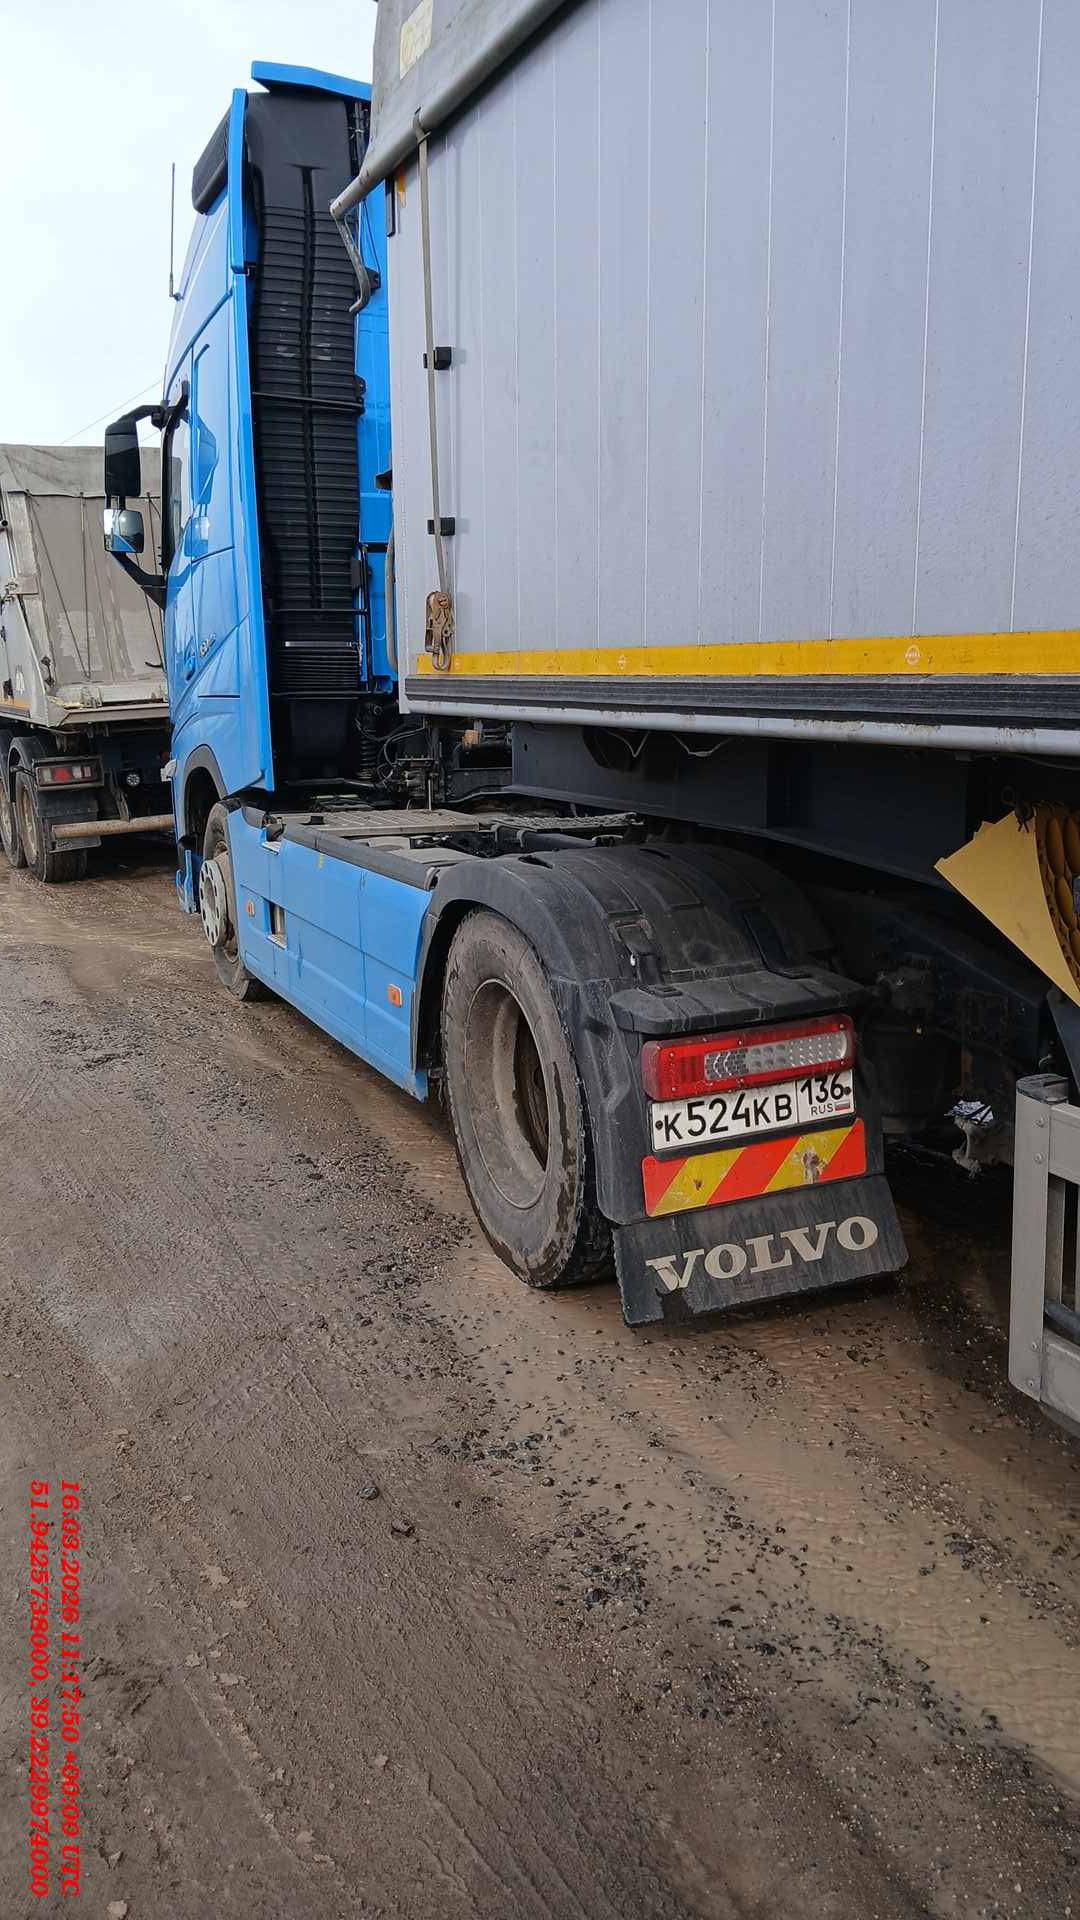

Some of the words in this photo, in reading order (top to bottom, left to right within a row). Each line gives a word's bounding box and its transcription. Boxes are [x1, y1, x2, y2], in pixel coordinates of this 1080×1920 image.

[800, 1073, 845, 1106] 136
[810, 1102, 834, 1116] RUS
[646, 1215, 879, 1292] VOLVO
